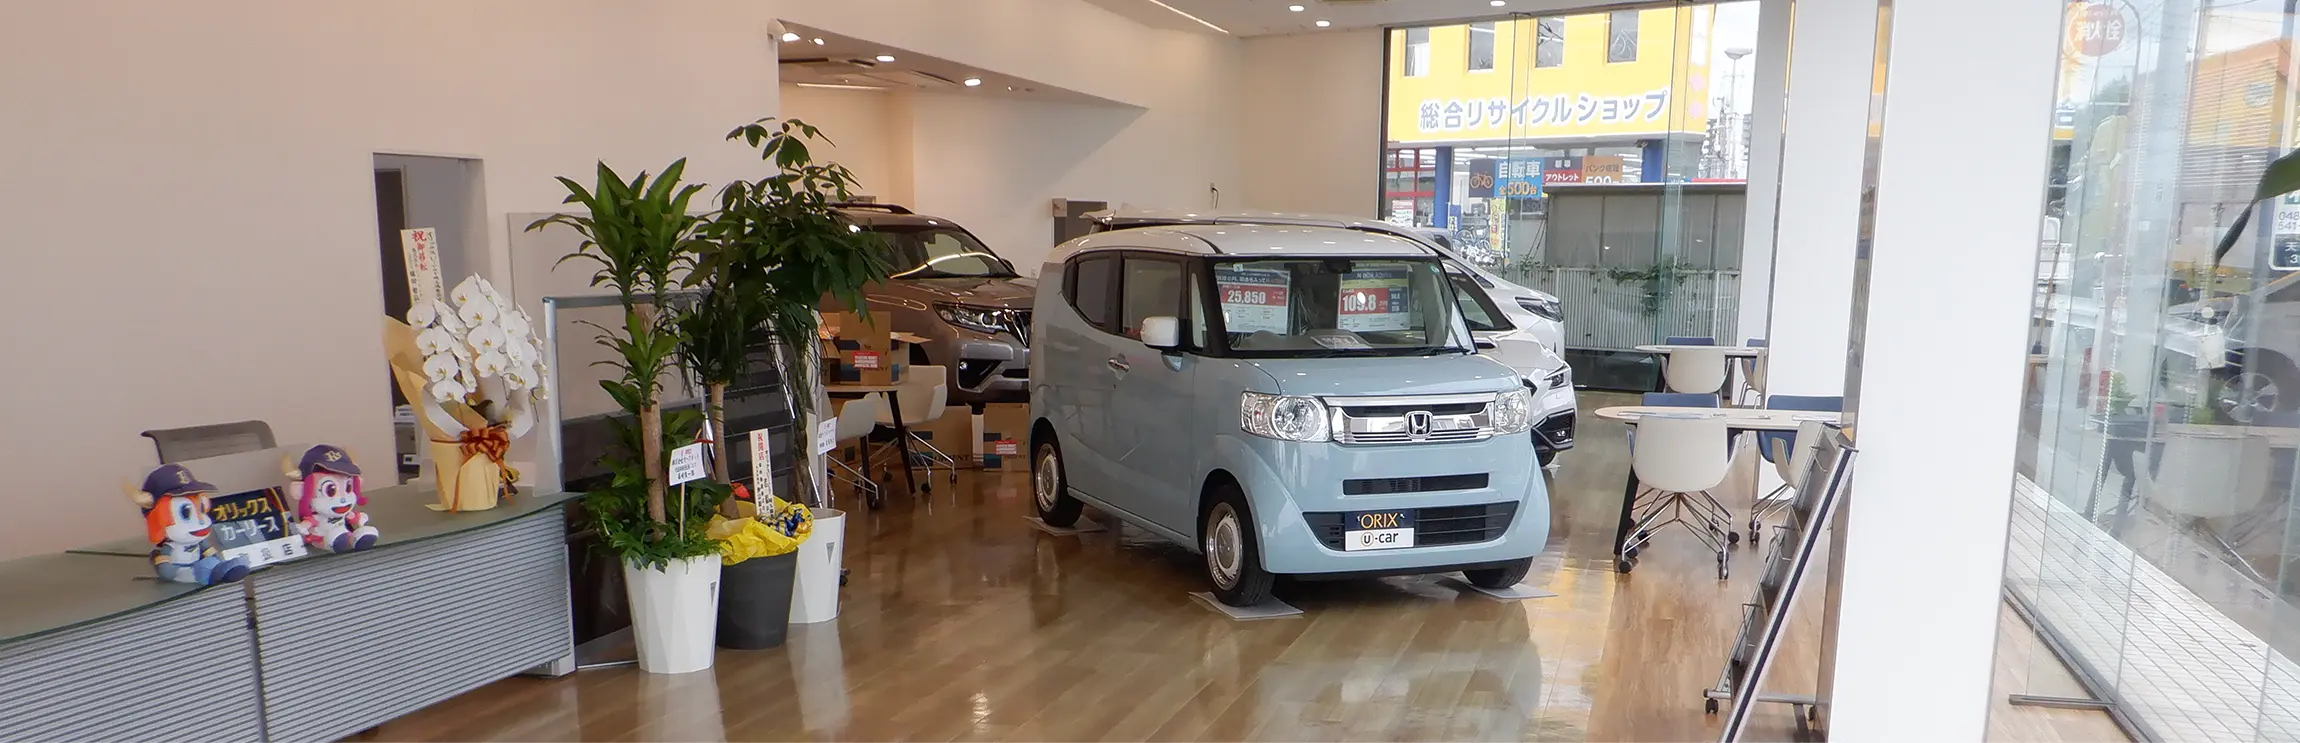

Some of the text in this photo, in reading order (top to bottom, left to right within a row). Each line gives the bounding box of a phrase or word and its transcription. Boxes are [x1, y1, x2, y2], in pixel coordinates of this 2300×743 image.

[2075, 19, 2121, 41] 消火栓
[1419, 90, 1669, 131] 総合リサイクルショップ
[1498, 160, 1541, 179] 自転車
[1545, 173, 1579, 182] アウトレット
[1499, 181, 1537, 196] 全500台
[1227, 289, 1266, 304] 25,850
[214, 498, 272, 521] オリックス
[220, 517, 280, 540] カーリース
[1361, 513, 1398, 529] ORIX
